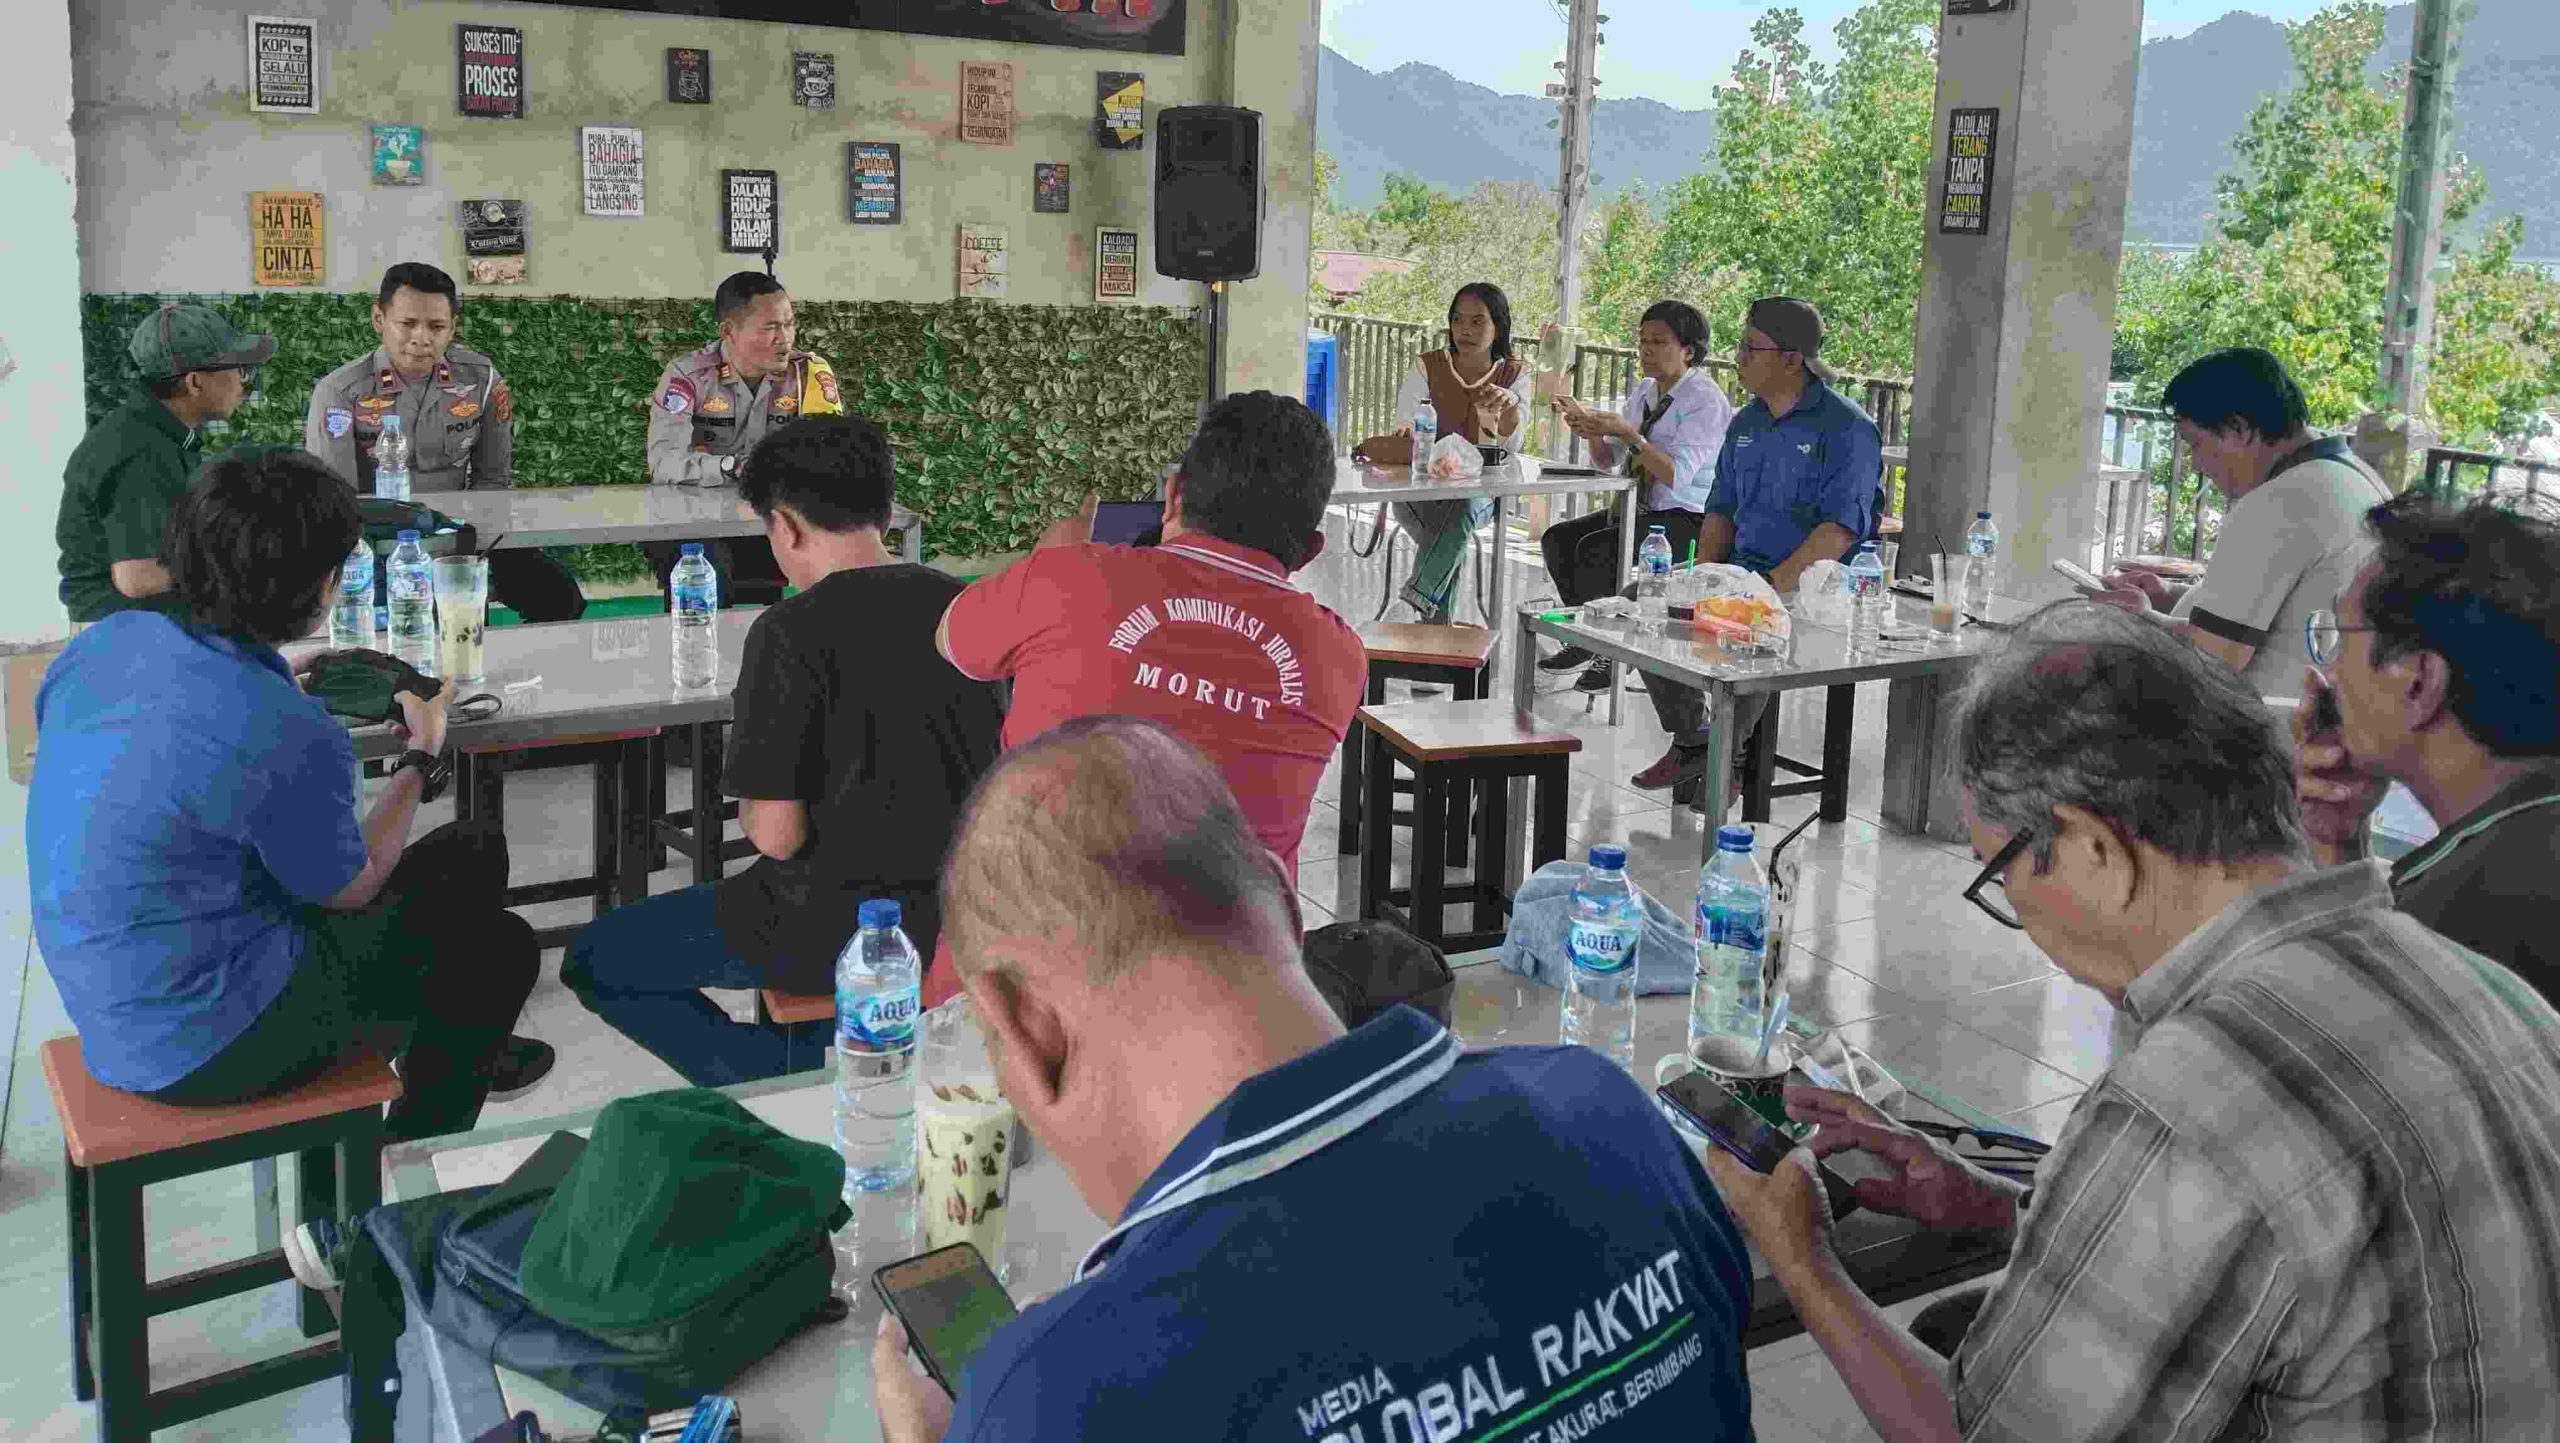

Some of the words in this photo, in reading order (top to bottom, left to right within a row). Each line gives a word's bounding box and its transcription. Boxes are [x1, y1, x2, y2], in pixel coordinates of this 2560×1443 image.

[262, 38, 291, 52] KOPI
[464, 31, 500, 53] SUKSES
[502, 33, 517, 54] ITU
[262, 61, 305, 74] SELALU
[465, 64, 517, 97] PROSES
[966, 94, 990, 110] KOPI
[1953, 115, 1990, 136] JADILAH
[588, 133, 606, 144] PURA
[611, 134, 629, 145] PURA
[1952, 137, 1988, 157] TERANG
[589, 143, 637, 165] BAHAGIA
[589, 164, 601, 176] ITU
[602, 165, 638, 177] GAMPANG
[854, 158, 895, 171] BAHAGIA
[1950, 158, 1984, 183] TANPA
[590, 182, 608, 192] PURA
[613, 183, 631, 193] PURA
[731, 184, 771, 197] DALAM
[590, 193, 638, 211] LANGSING
[731, 197, 771, 212] HIDUP
[855, 200, 895, 212] MEMBERI
[1945, 195, 1981, 214] CAHAYA
[263, 206, 284, 229] HA
[290, 206, 313, 229] HA
[731, 219, 771, 233] DALAM
[732, 231, 771, 247] MIMPI
[263, 246, 313, 271] CINTA
[1103, 281, 1133, 293] MAKSA
[1108, 604, 1161, 654] FORUM
[1162, 597, 1266, 642] KOMUNIKASI
[1260, 633, 1304, 707] JURNALIS
[1132, 662, 1272, 720] MORUT
[1574, 929, 1622, 953] AQUA
[868, 995, 917, 1021] AQUA
[1531, 1249, 1684, 1388] RAKYAT
[1296, 1364, 1395, 1437] MEDIA
